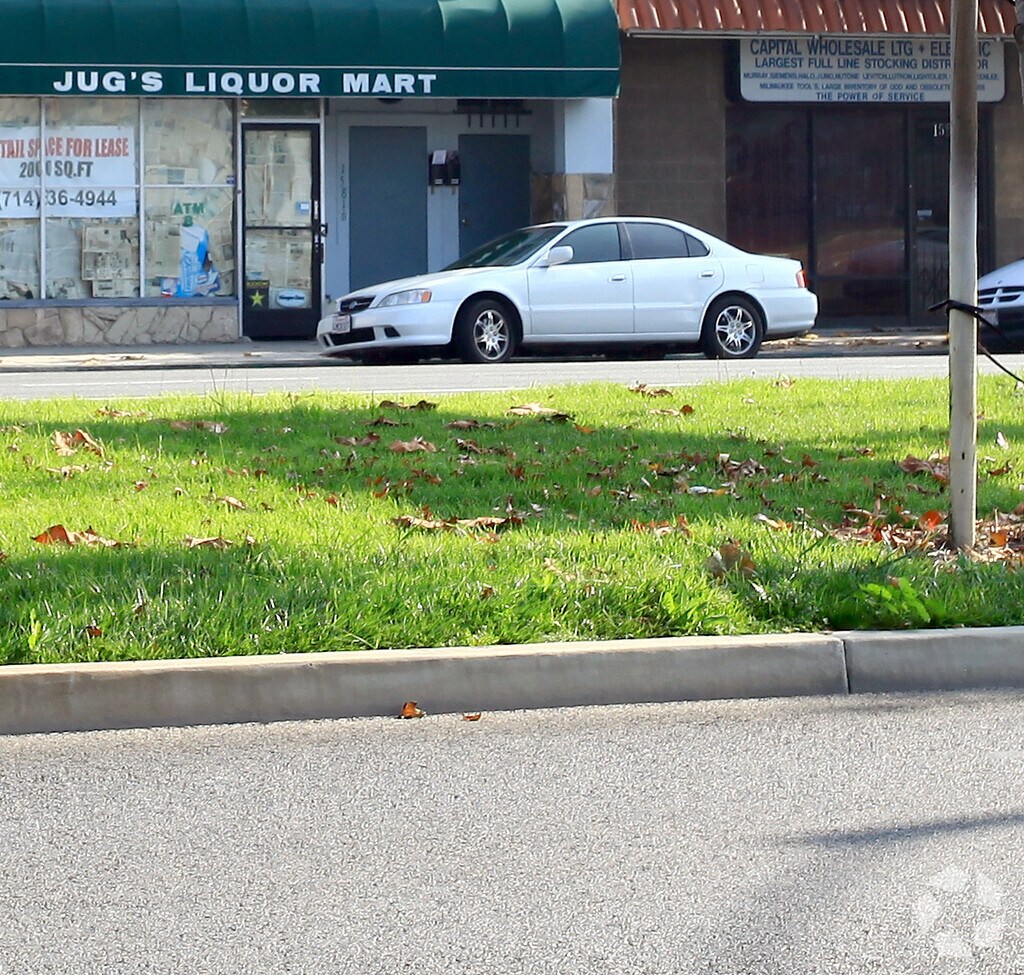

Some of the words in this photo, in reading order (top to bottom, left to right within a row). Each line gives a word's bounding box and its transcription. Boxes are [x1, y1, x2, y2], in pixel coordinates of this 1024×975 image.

[750, 39, 802, 56] CAPITAL
[807, 39, 886, 56] WHOLESALE
[891, 40, 913, 57] LTG
[755, 57, 804, 69] LARGEST
[808, 57, 833, 69] FULL
[837, 58, 860, 69] LINE
[864, 58, 918, 70] STOCKING
[53, 71, 163, 92] JUG'S
[185, 72, 320, 95] LIQUOR
[342, 73, 437, 94] MART
[816, 92, 833, 101] THE
[837, 92, 868, 101] POWER
[872, 92, 884, 101] OF
[888, 92, 925, 101] SERVICE
[66, 137, 92, 158] FOR
[95, 137, 129, 158] LEASE
[174, 202, 205, 215] ATM
